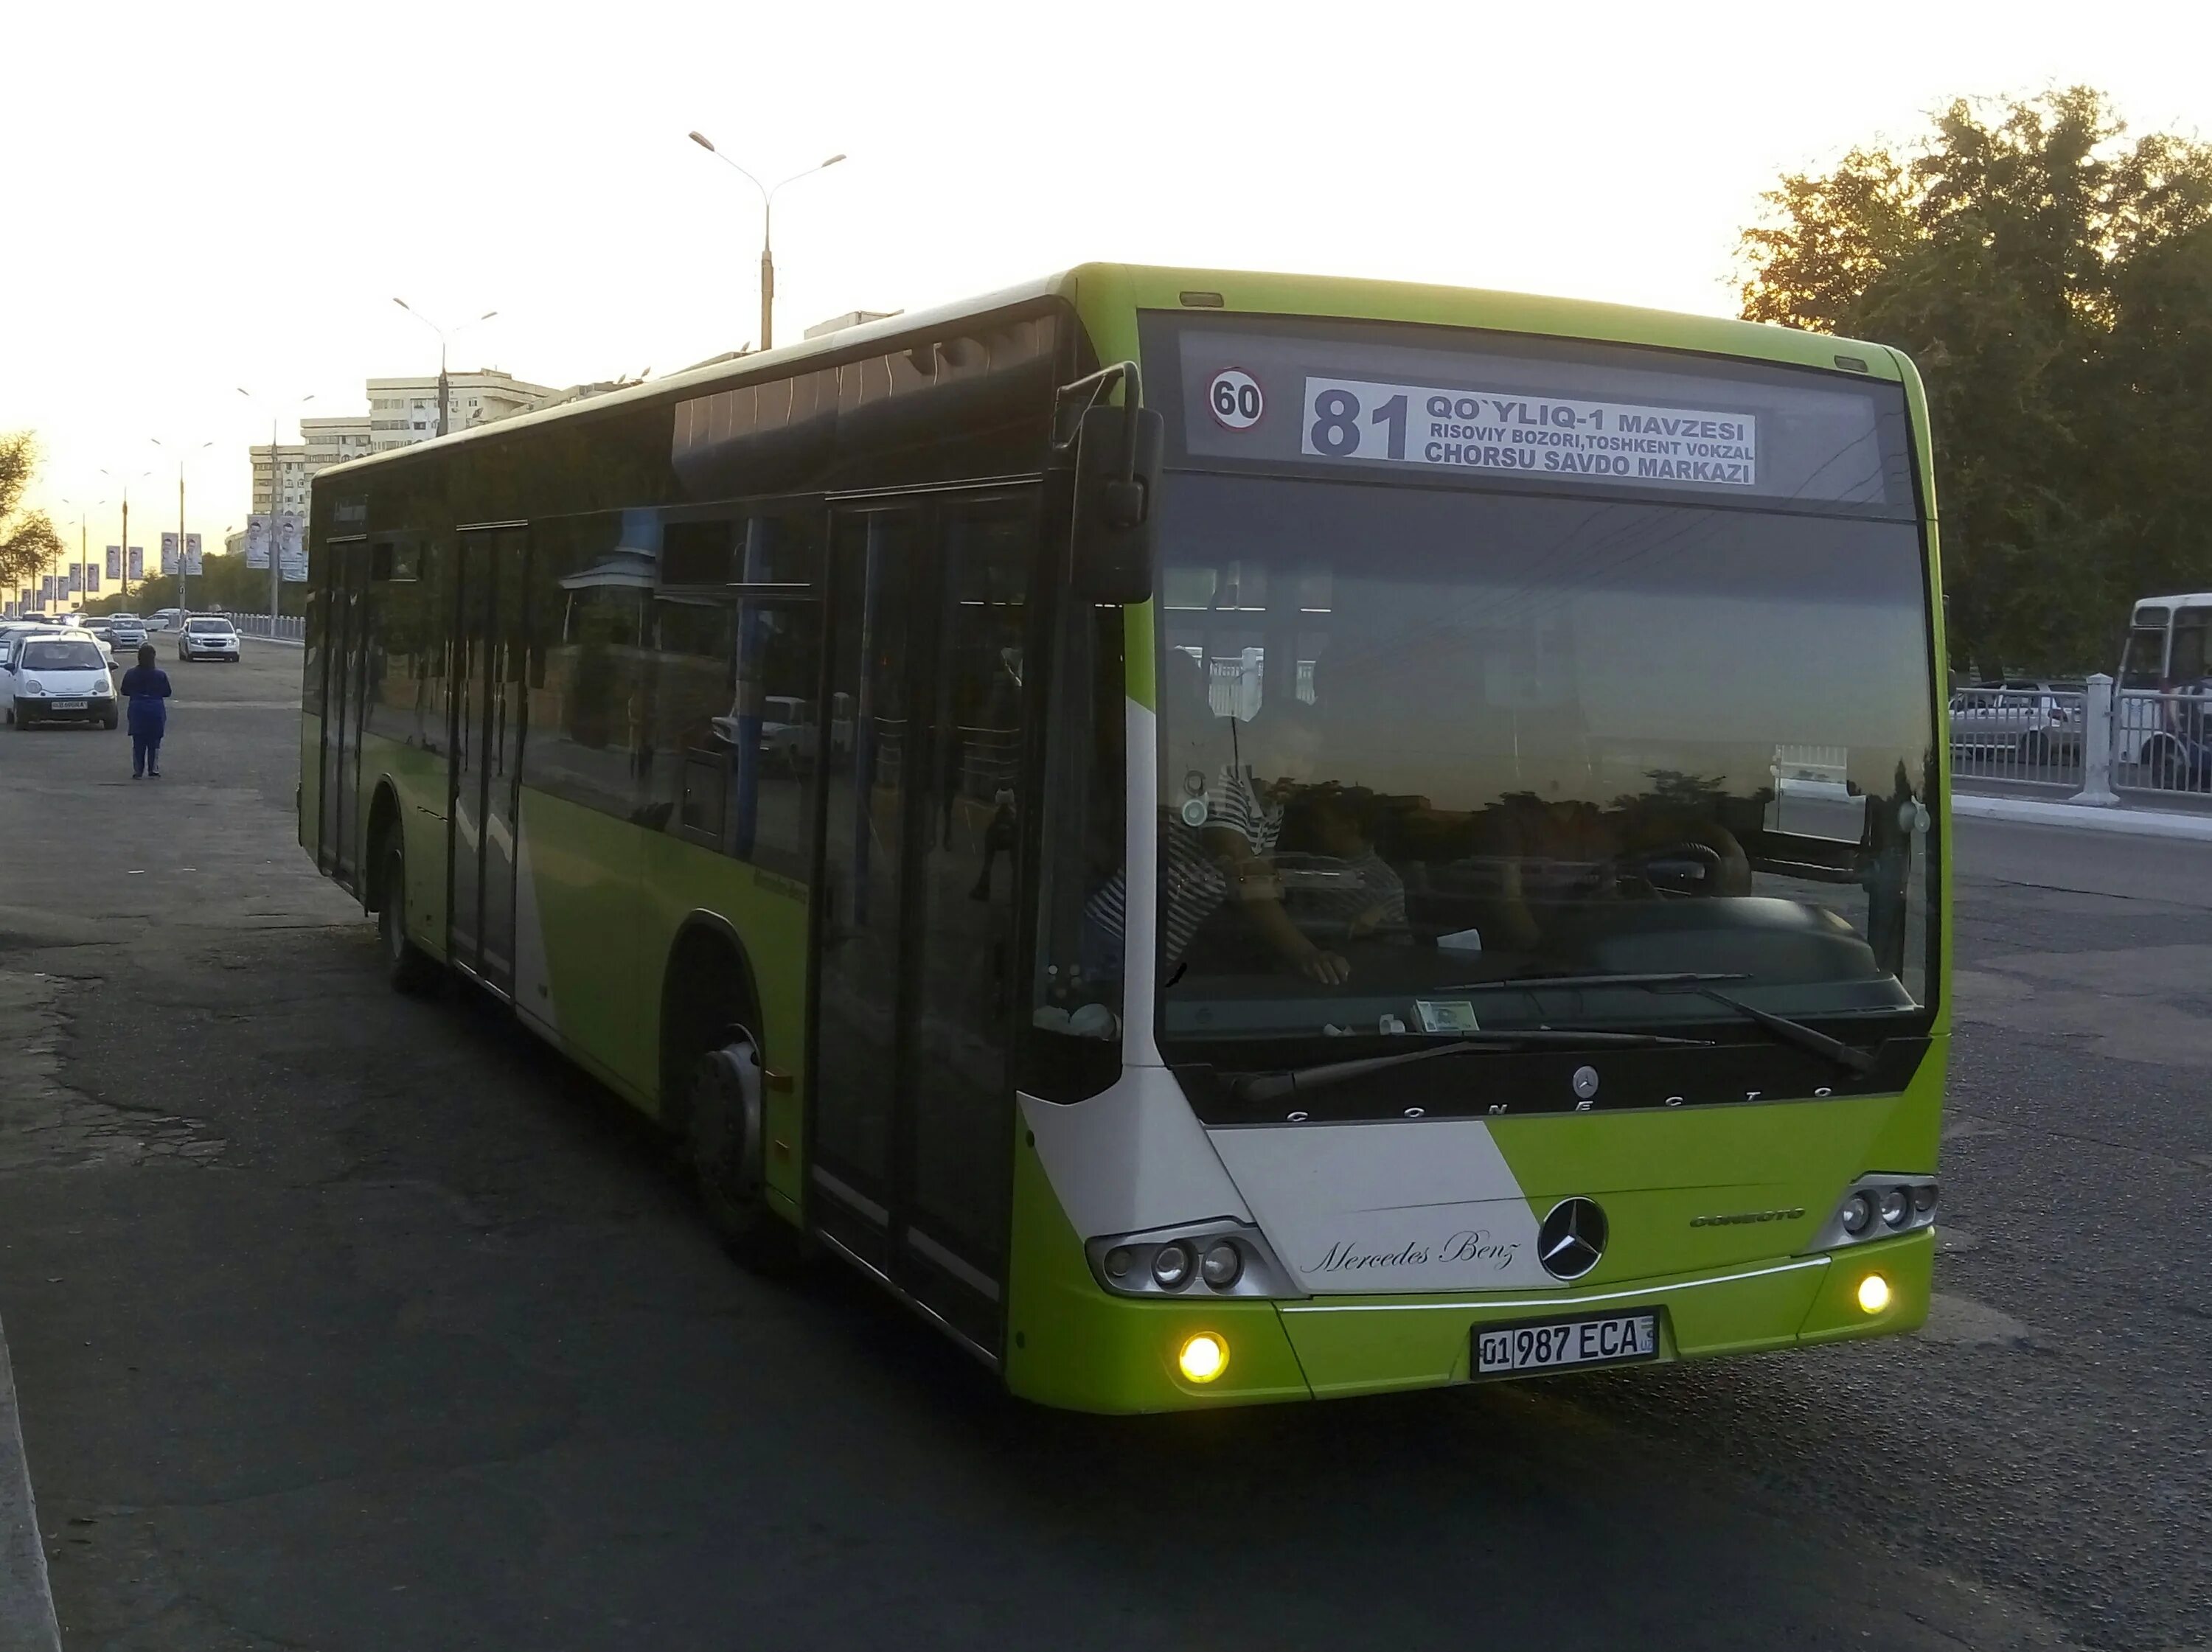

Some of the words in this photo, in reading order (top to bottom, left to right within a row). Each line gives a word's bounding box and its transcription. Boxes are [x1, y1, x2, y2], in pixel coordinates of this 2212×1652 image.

[1213, 380, 1260, 419] 60
[1310, 388, 1408, 461] 81
[1430, 422, 1507, 443] RISOVIY
[1686, 442, 1755, 461] VOKZAL
[1619, 414, 1745, 441] MAVZESI
[1425, 442, 1537, 469] CHORSU
[1544, 450, 1630, 475] SAVDO
[1637, 458, 1750, 484] MARKAZI
[1287, 1087, 1832, 1123] CONECTO
[1299, 1241, 1430, 1274] Mercedes
[1438, 1229, 1522, 1271] Benz
[1482, 1337, 1511, 1365] 01
[1517, 1326, 1571, 1366] 987
[1579, 1319, 1638, 1359] ECA
